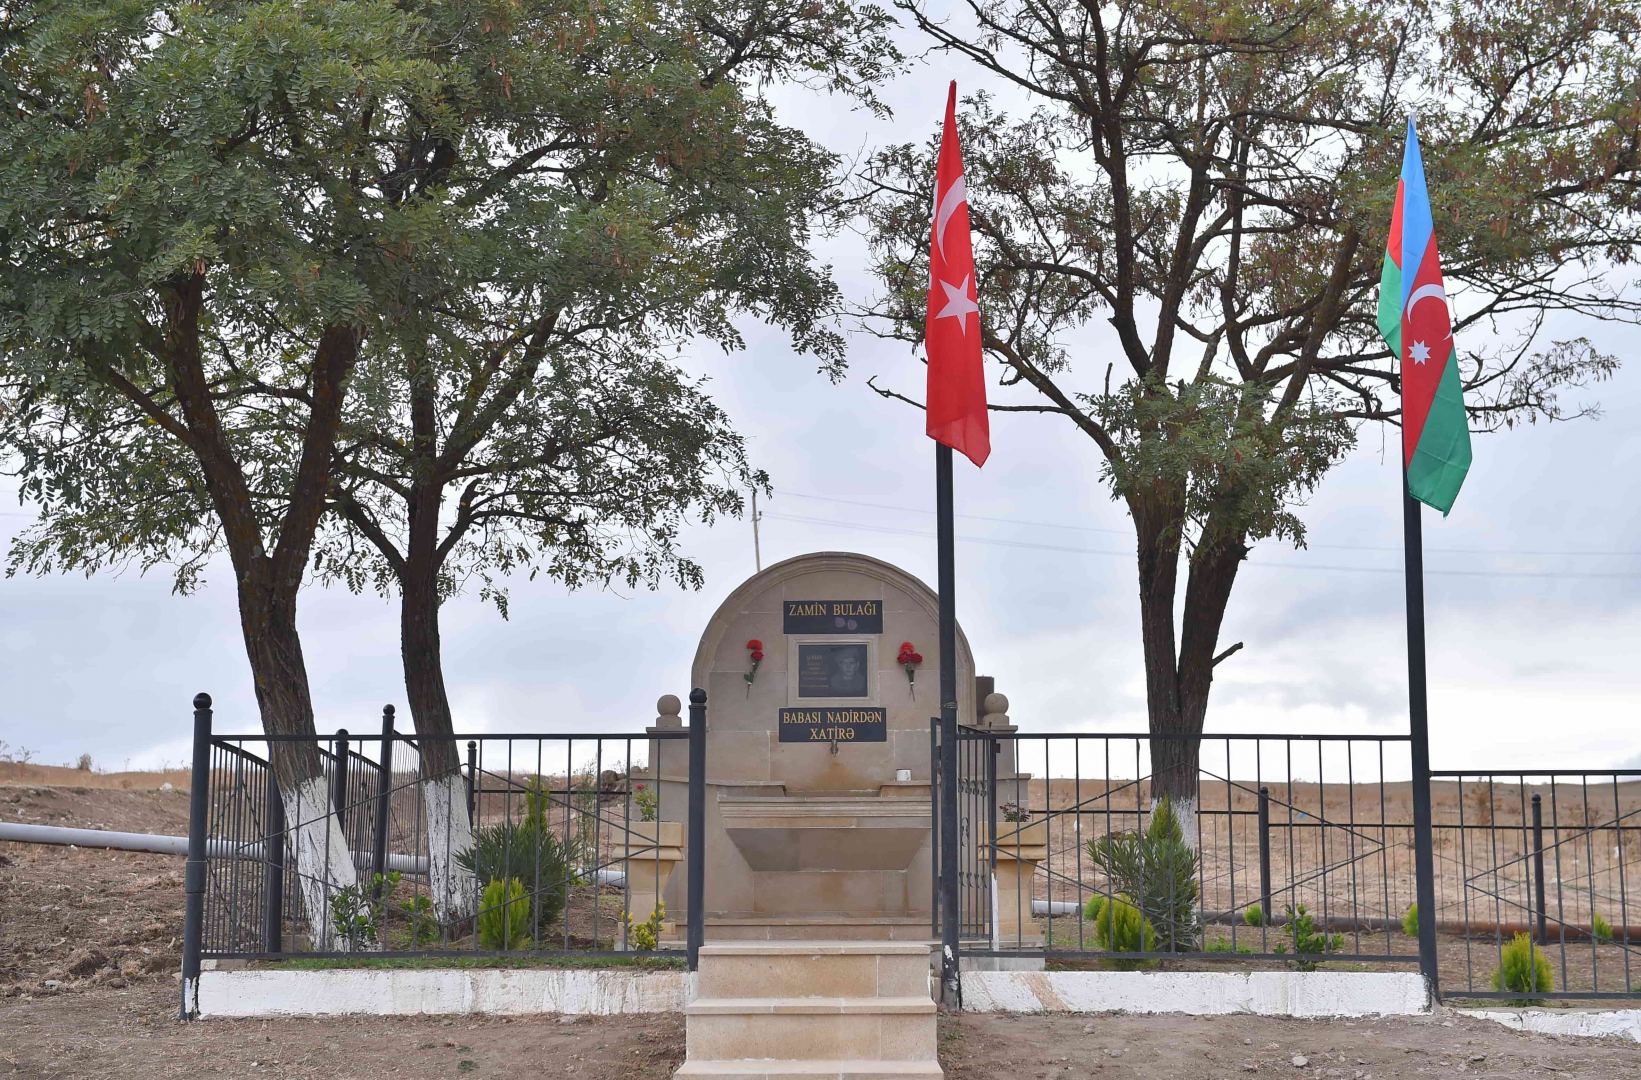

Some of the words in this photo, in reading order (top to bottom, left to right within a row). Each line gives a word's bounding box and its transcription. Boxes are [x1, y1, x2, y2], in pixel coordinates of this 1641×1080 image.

[789, 602, 826, 616] ZAMİN
[833, 602, 876, 616] BULAĞI
[783, 712, 821, 723] BABASI
[827, 710, 881, 723] NADİRDƏN
[810, 726, 855, 740] XATİRƏ
